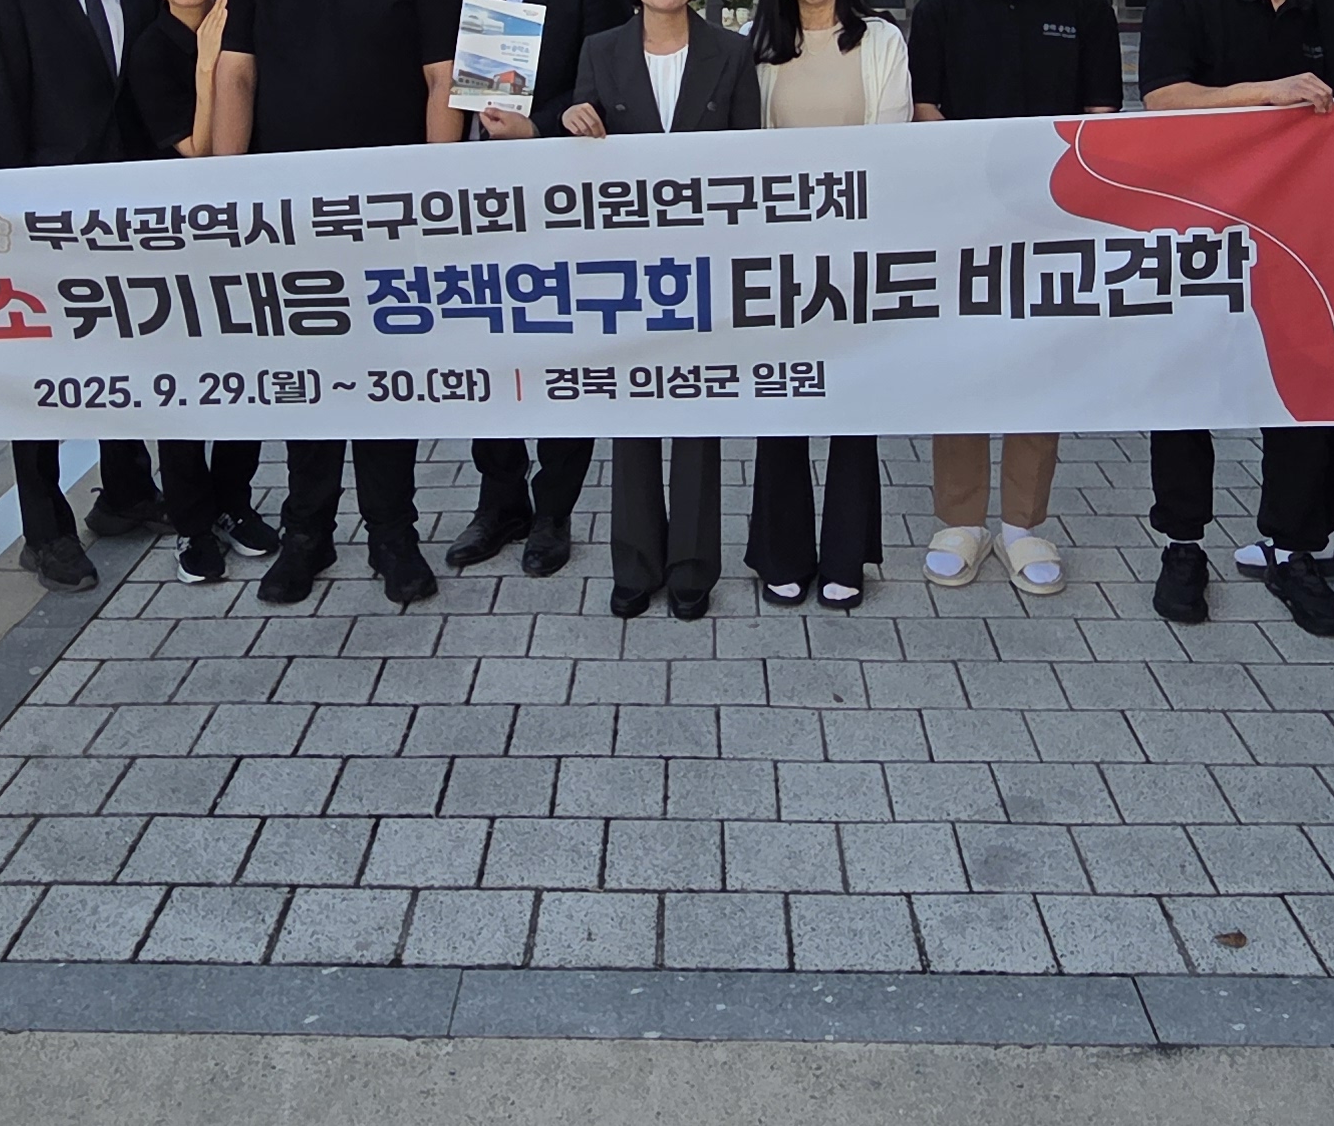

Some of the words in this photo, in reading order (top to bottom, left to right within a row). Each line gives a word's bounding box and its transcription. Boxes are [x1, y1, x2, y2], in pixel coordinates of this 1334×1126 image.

[25, 204, 296, 252] 부산광역시
[311, 187, 527, 243] 북구의회
[544, 170, 868, 229] 의원연구단체
[59, 272, 204, 340] 위기
[216, 269, 353, 338] 대응
[364, 256, 713, 336] 정책연구회
[731, 250, 940, 329] 타시도
[958, 230, 1250, 320] 비교견학
[33, 375, 142, 410] 2025.
[153, 373, 188, 407] 9.
[198, 369, 322, 406] 29.(월)
[367, 367, 492, 403] 30.(화)
[544, 366, 618, 400] 경북
[629, 364, 740, 399] 의성군
[752, 360, 826, 398] 일원
